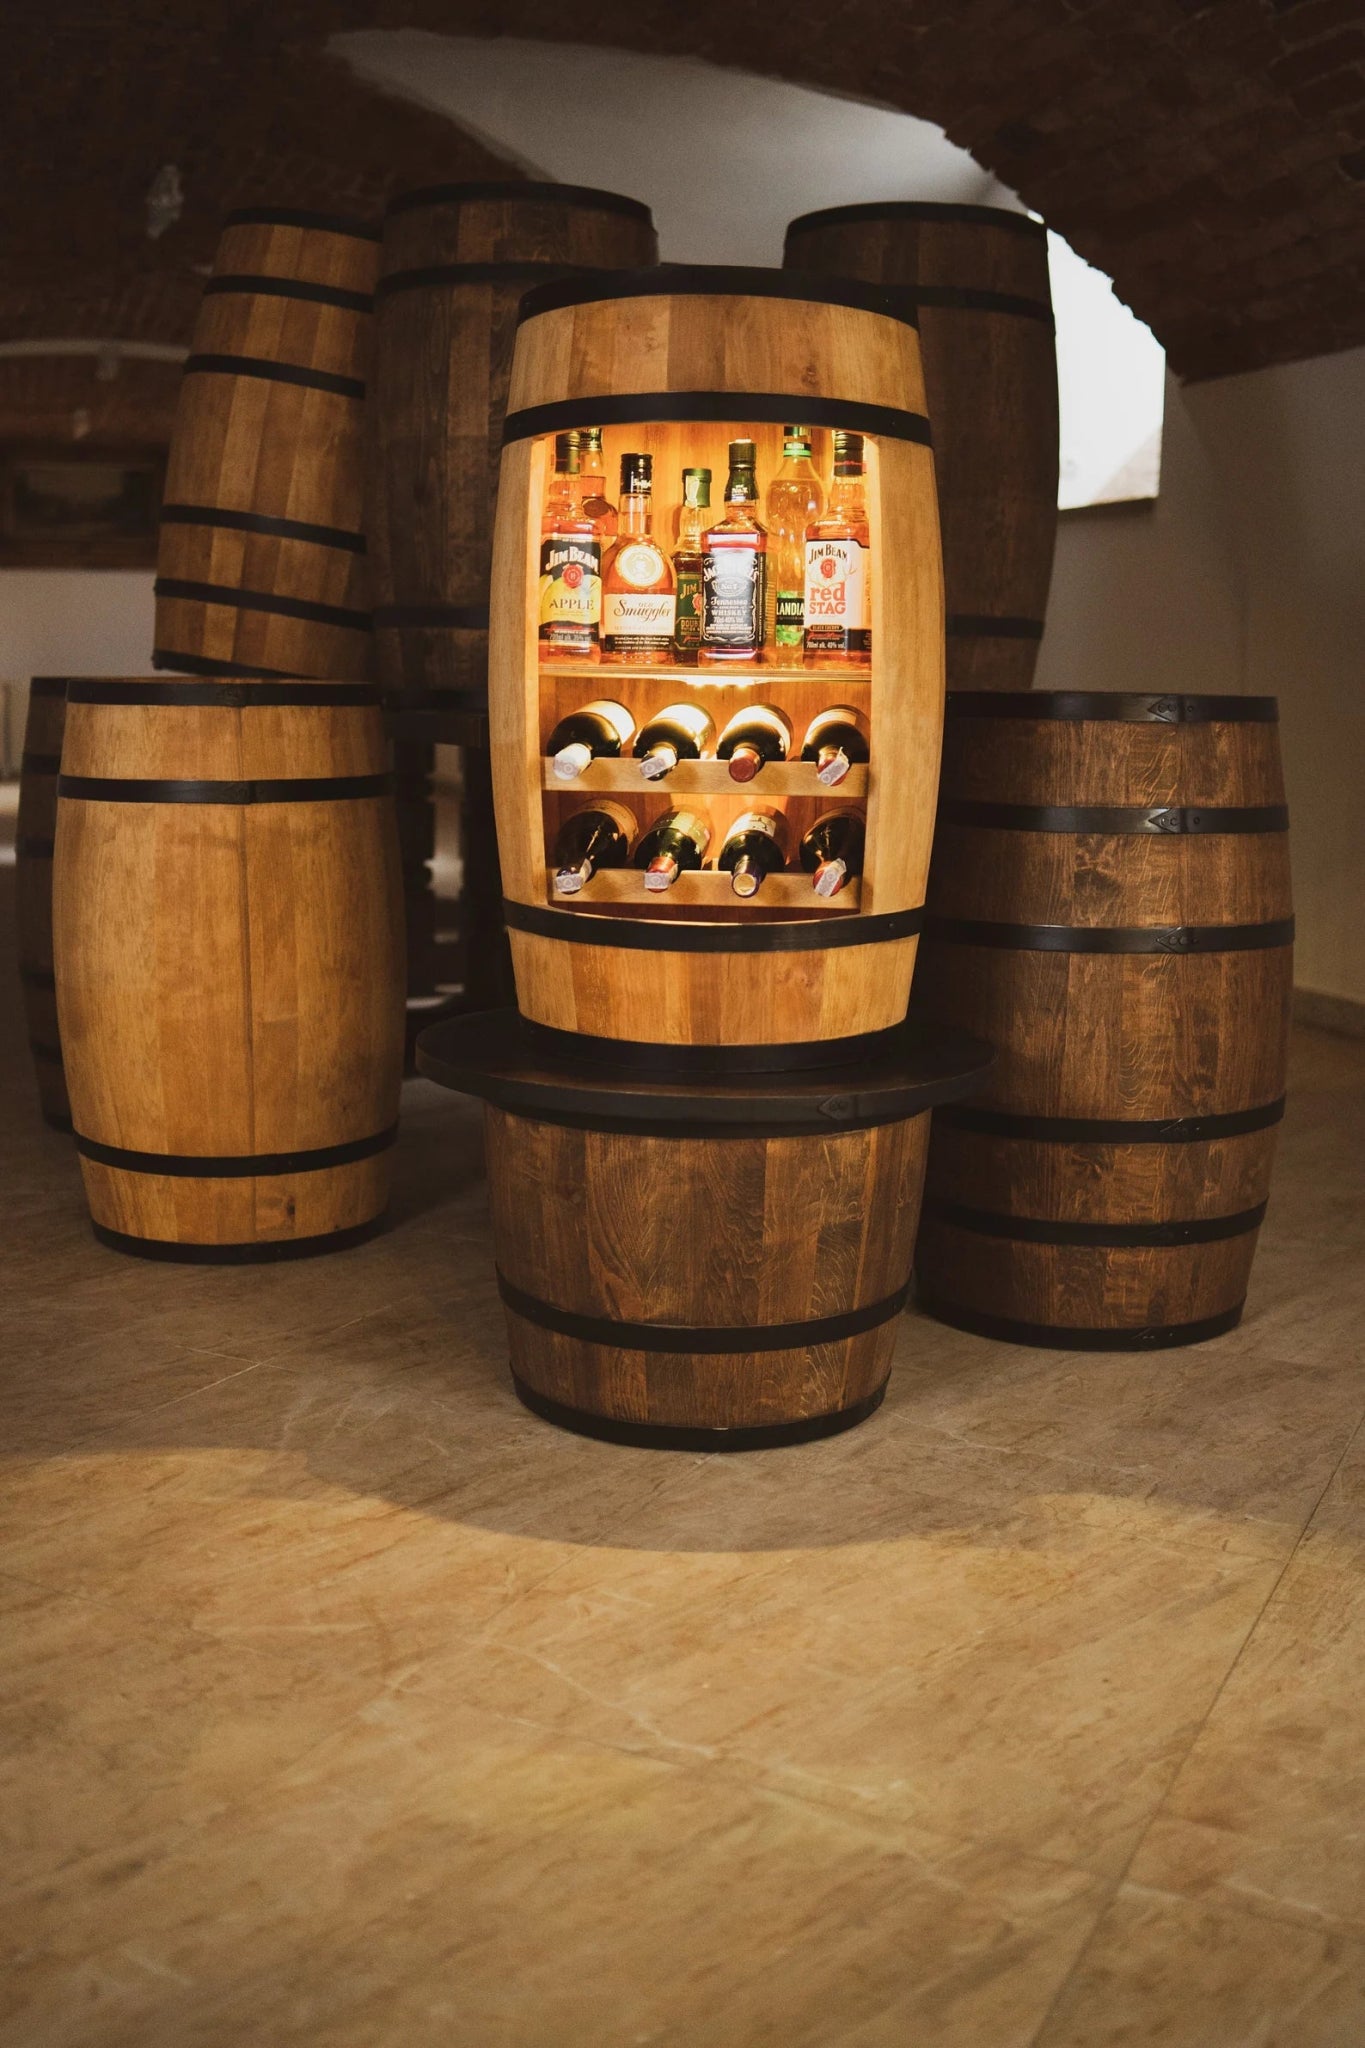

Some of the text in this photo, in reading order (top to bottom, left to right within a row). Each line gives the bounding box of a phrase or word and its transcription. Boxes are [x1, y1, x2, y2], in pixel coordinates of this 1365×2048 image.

[545, 546, 599, 575] JIM BEAM
[809, 544, 848, 564] JIM BEAM
[680, 584, 697, 599] JIM
[810, 581, 846, 601] red
[549, 599, 594, 610] APPLE
[613, 599, 671, 621] Smuggler
[776, 603, 804, 616] LANDIA
[809, 602, 846, 615] STAG
